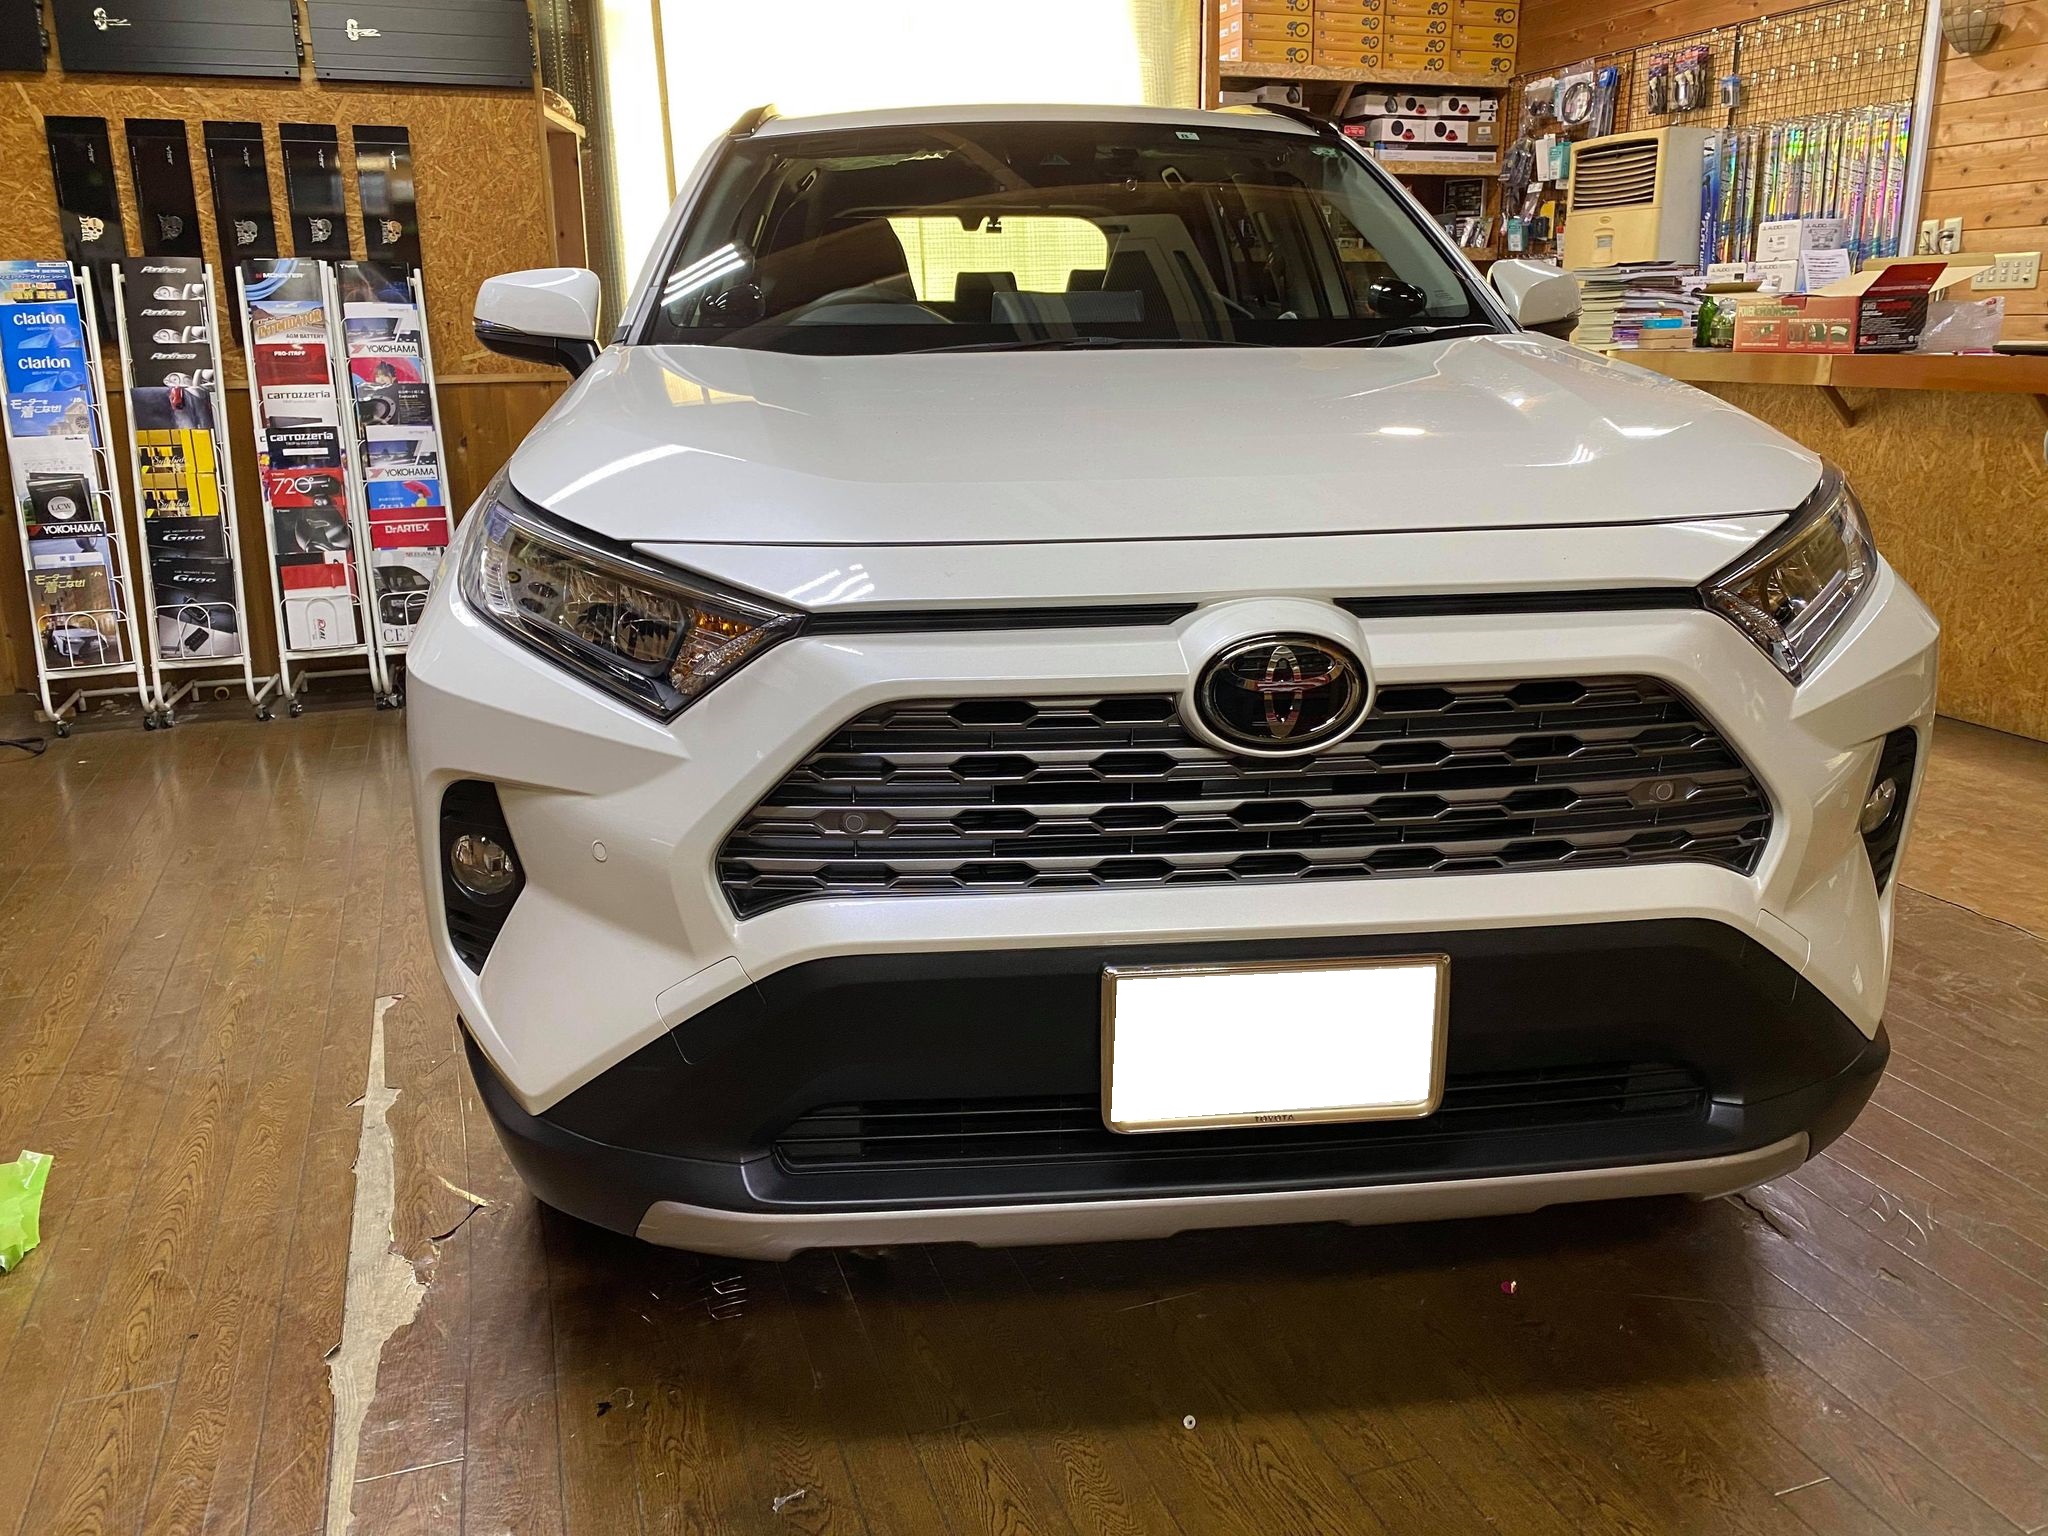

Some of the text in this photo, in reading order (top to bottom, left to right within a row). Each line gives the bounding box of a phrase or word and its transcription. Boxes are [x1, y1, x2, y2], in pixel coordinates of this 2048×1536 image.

[13, 311, 66, 326] Clarion
[366, 344, 417, 353] YOKOHAMA
[18, 356, 71, 370] Clarion
[267, 390, 331, 400] carrozzeria
[269, 431, 334, 442] carrozzeria
[385, 467, 435, 477] YOKOHAMA
[50, 503, 72, 511] LCW
[42, 523, 102, 535] YOKOHAMA
[1254, 1114, 1295, 1123] TOYOTA
